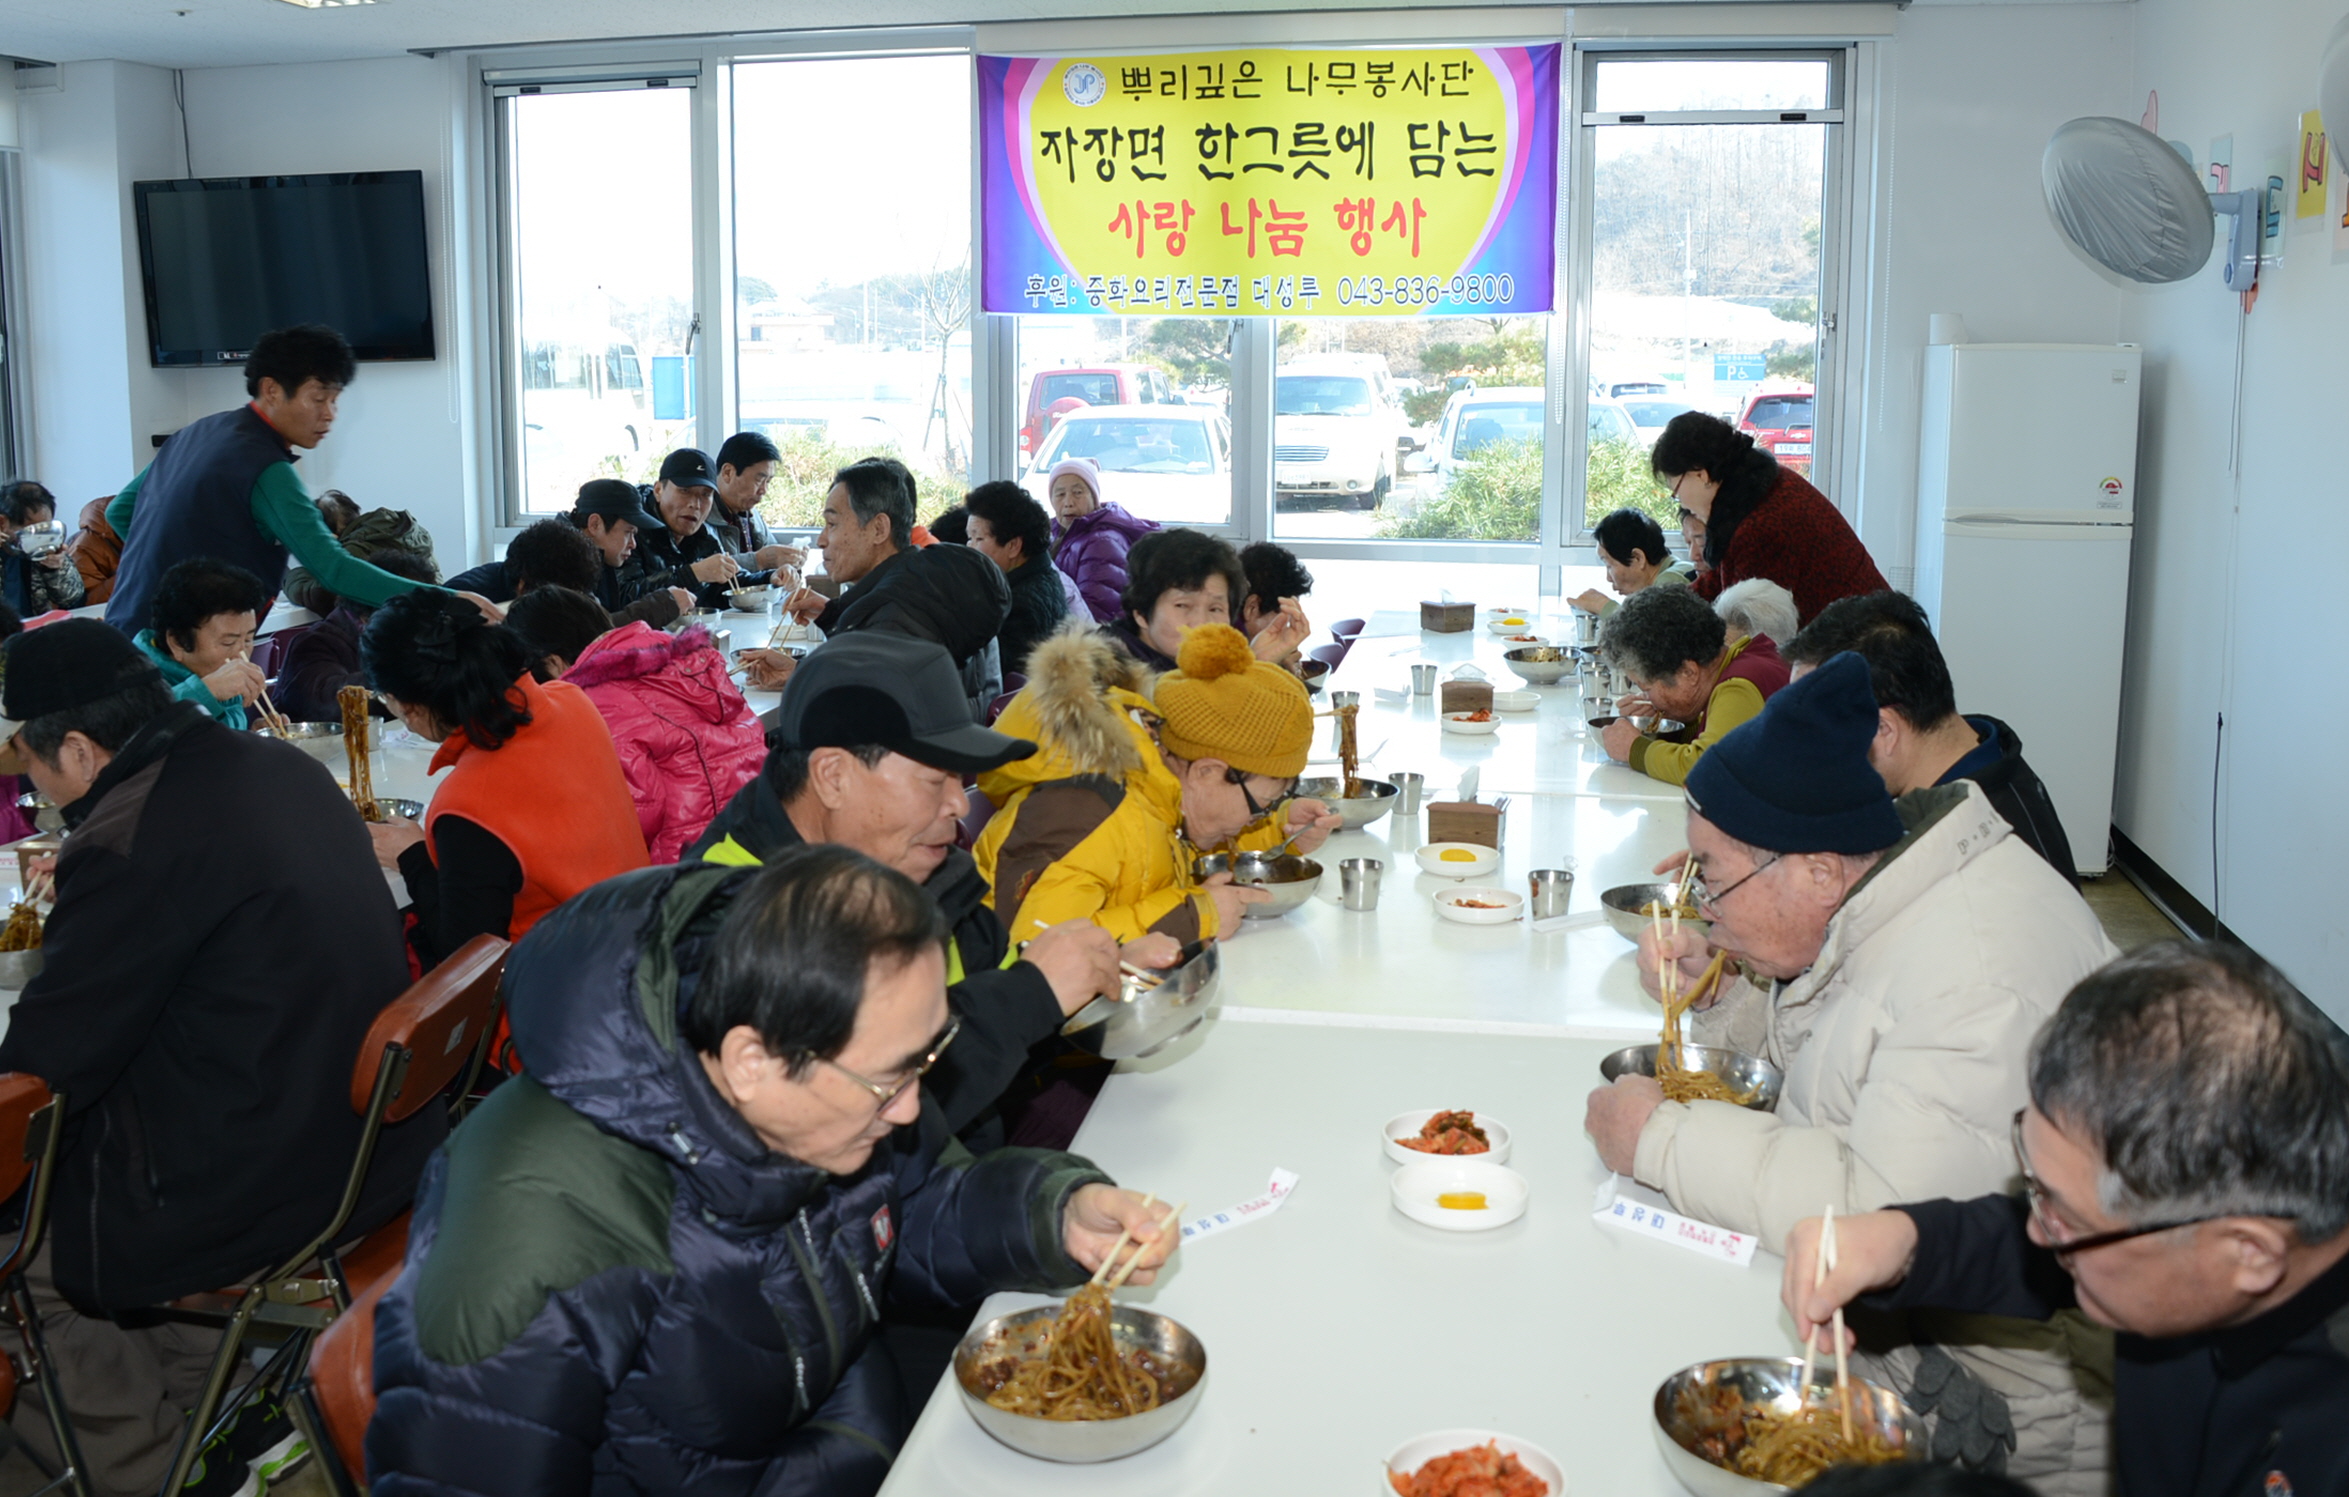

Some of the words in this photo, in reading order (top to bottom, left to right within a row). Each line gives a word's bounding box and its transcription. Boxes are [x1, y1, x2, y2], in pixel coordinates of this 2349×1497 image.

[1121, 60, 1263, 102] 뿌리깊은
[1287, 60, 1474, 98] 나무봉사단
[1040, 124, 1167, 183] 자장면
[1195, 121, 1374, 181] 한그릇에
[1407, 120, 1497, 178] 담는
[1108, 199, 1196, 258] 사랑
[1220, 197, 1308, 258] 나눔
[1333, 197, 1427, 258] 행사
[1025, 274, 1077, 308] 후원:
[1085, 275, 1240, 308] 중화요리전문점
[1252, 275, 1321, 309] 대성루
[1336, 273, 1515, 305] 043-836-9800
